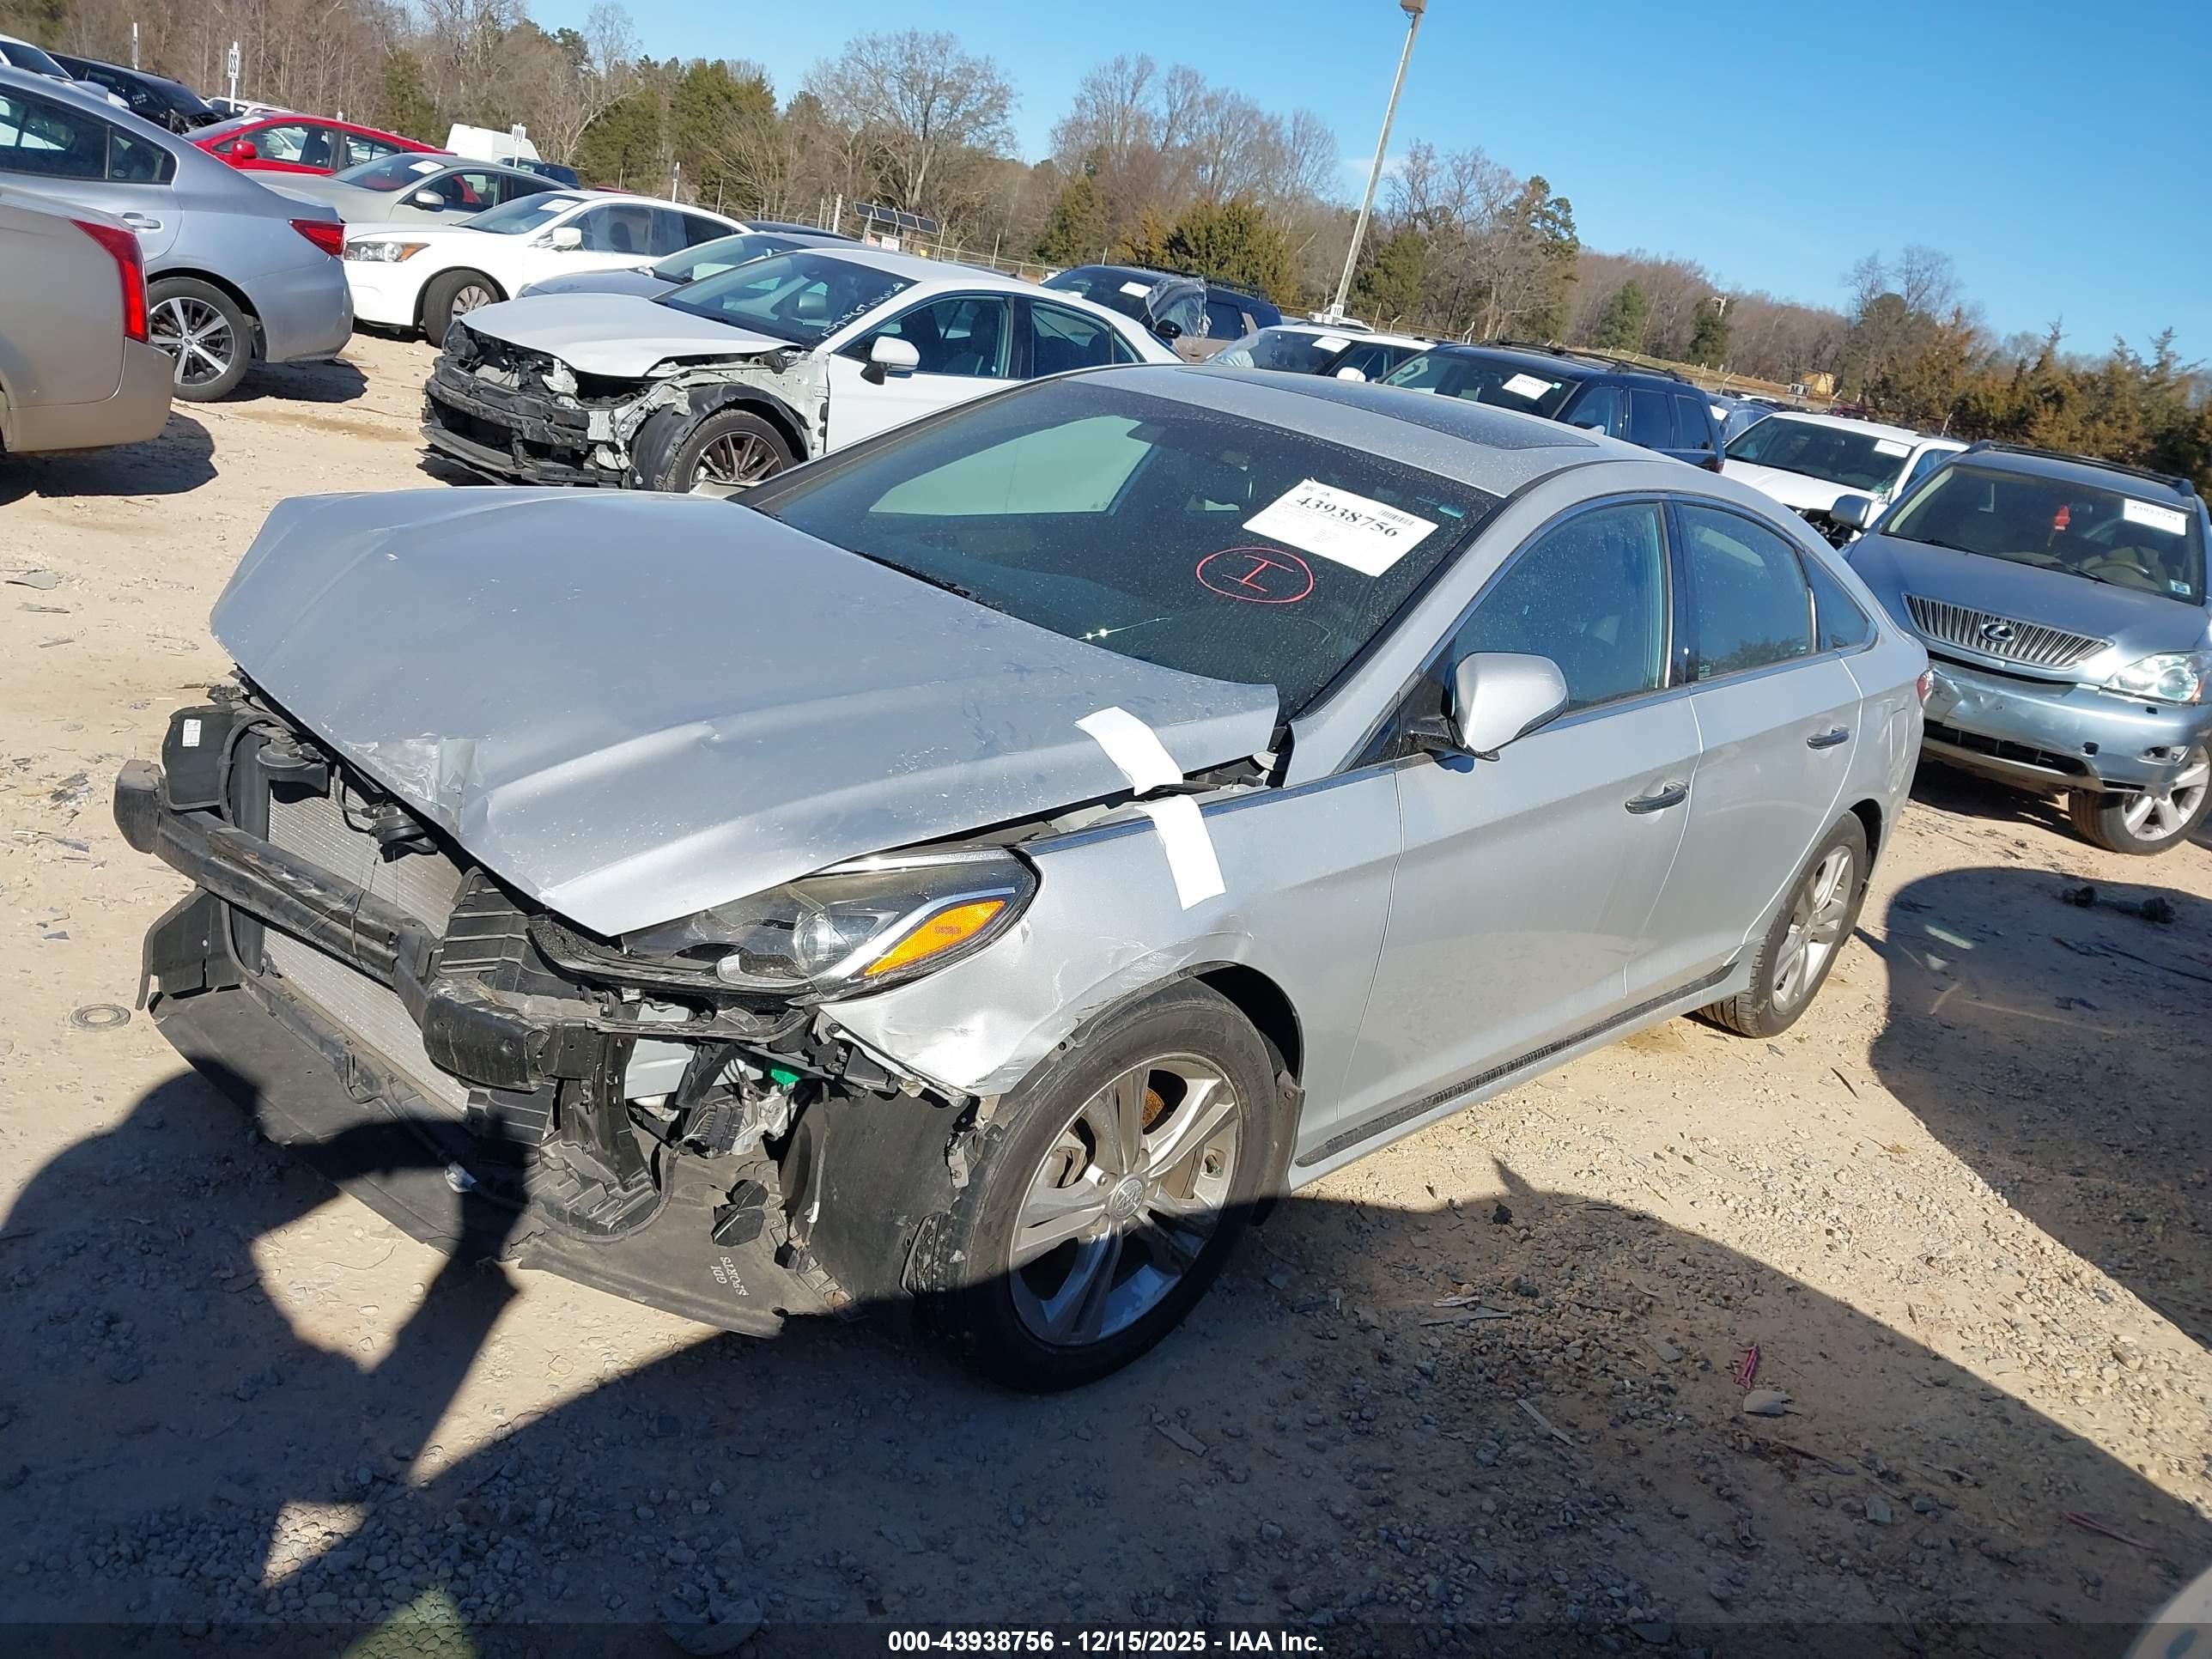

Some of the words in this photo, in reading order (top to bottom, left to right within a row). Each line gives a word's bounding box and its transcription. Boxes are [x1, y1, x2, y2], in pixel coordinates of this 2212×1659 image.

[229, 53, 238, 74] SS
[1334, 307, 1342, 316] 10
[1296, 497, 1401, 538] 43938756
